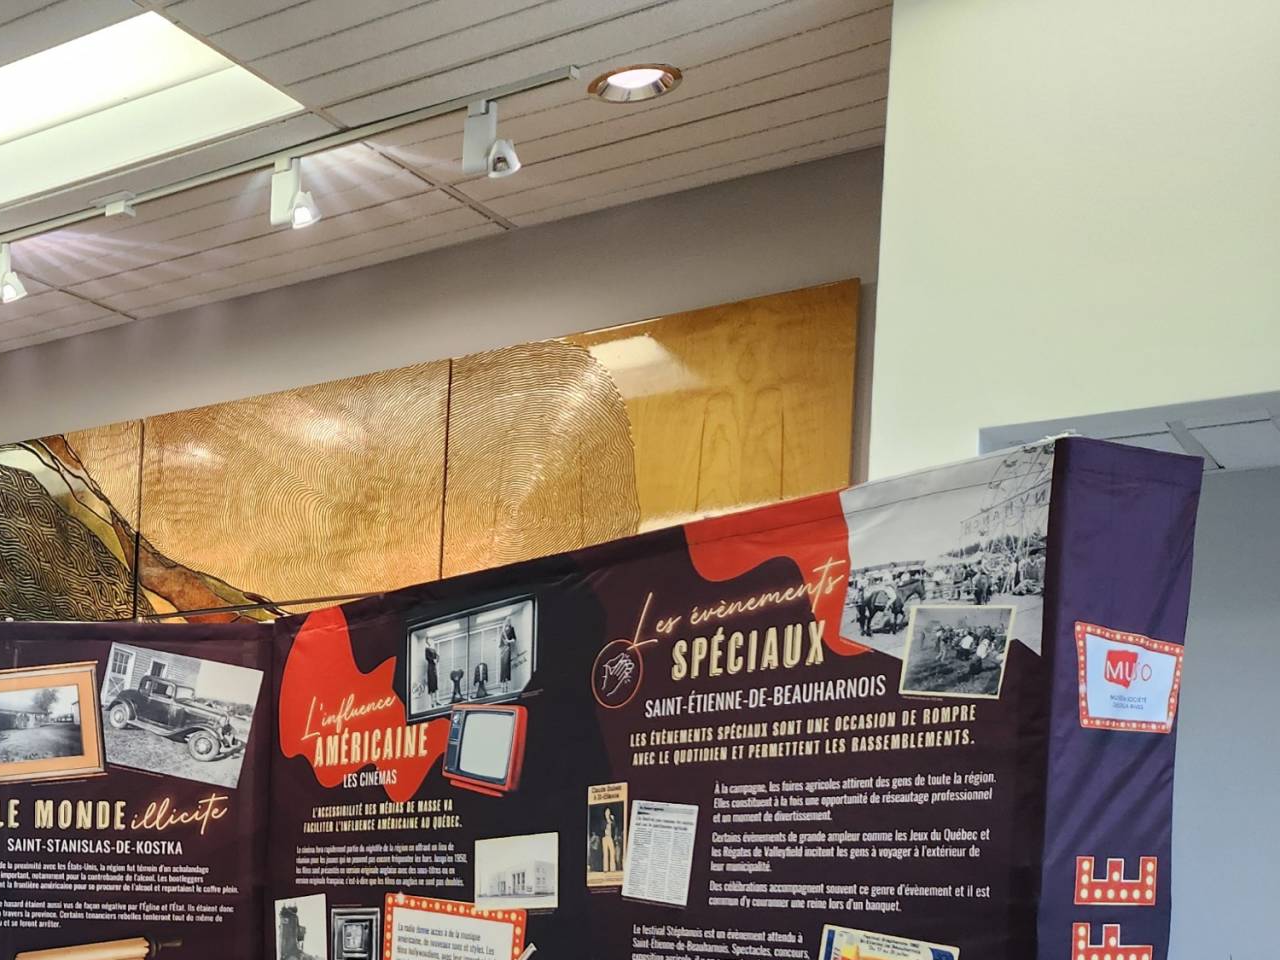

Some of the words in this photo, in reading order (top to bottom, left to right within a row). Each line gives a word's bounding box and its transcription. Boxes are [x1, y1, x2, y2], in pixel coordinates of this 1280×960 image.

[627, 592, 683, 649] Les
[692, 558, 847, 624] évènements
[672, 620, 826, 682] SPÉCIAUX
[645, 675, 886, 718] SAINT-ÉTIENNE-DE-BEAUHARNOIS
[302, 694, 396, 740] L'influence
[630, 733, 647, 746] LES
[650, 724, 713, 745] ÉVÈNEMENTS
[717, 719, 768, 740] SPÉCIAUX
[772, 720, 801, 736] SONT
[806, 718, 829, 734] UNE
[834, 712, 896, 732] OCCASION
[902, 710, 916, 726] DE
[923, 705, 978, 725] ROMPRE
[314, 724, 428, 767] AMÉRICAINE
[633, 752, 655, 766] AVEC
[659, 751, 669, 764] LE
[673, 747, 728, 763] QUOTIDIEN
[731, 746, 743, 760] ET
[748, 740, 819, 759] PERMETTENT
[825, 739, 846, 754] LES
[851, 730, 976, 752] RASSEMBLEMENTS.
[343, 774, 357, 788] LES
[359, 768, 397, 787] CINÉMAS
[842, 777, 872, 788] attirent
[875, 776, 889, 786] des
[891, 777, 912, 788] gens
[914, 775, 925, 785] de
[927, 774, 950, 784] toute
[953, 773, 961, 783] la
[964, 772, 996, 785] région.
[34, 799, 126, 830] MONDE
[130, 793, 228, 835] illicite
[432, 814, 463, 828] QUÉBEC.
[443, 800, 454, 811] VA
[7, 838, 182, 855] SAINT-STANISLAS-DE-KOSTKA
[862, 832, 892, 841] comme
[895, 830, 907, 841] les
[909, 830, 927, 841] Jeux
[930, 830, 941, 840] du
[943, 829, 977, 840] Québec
[980, 829, 990, 840] et
